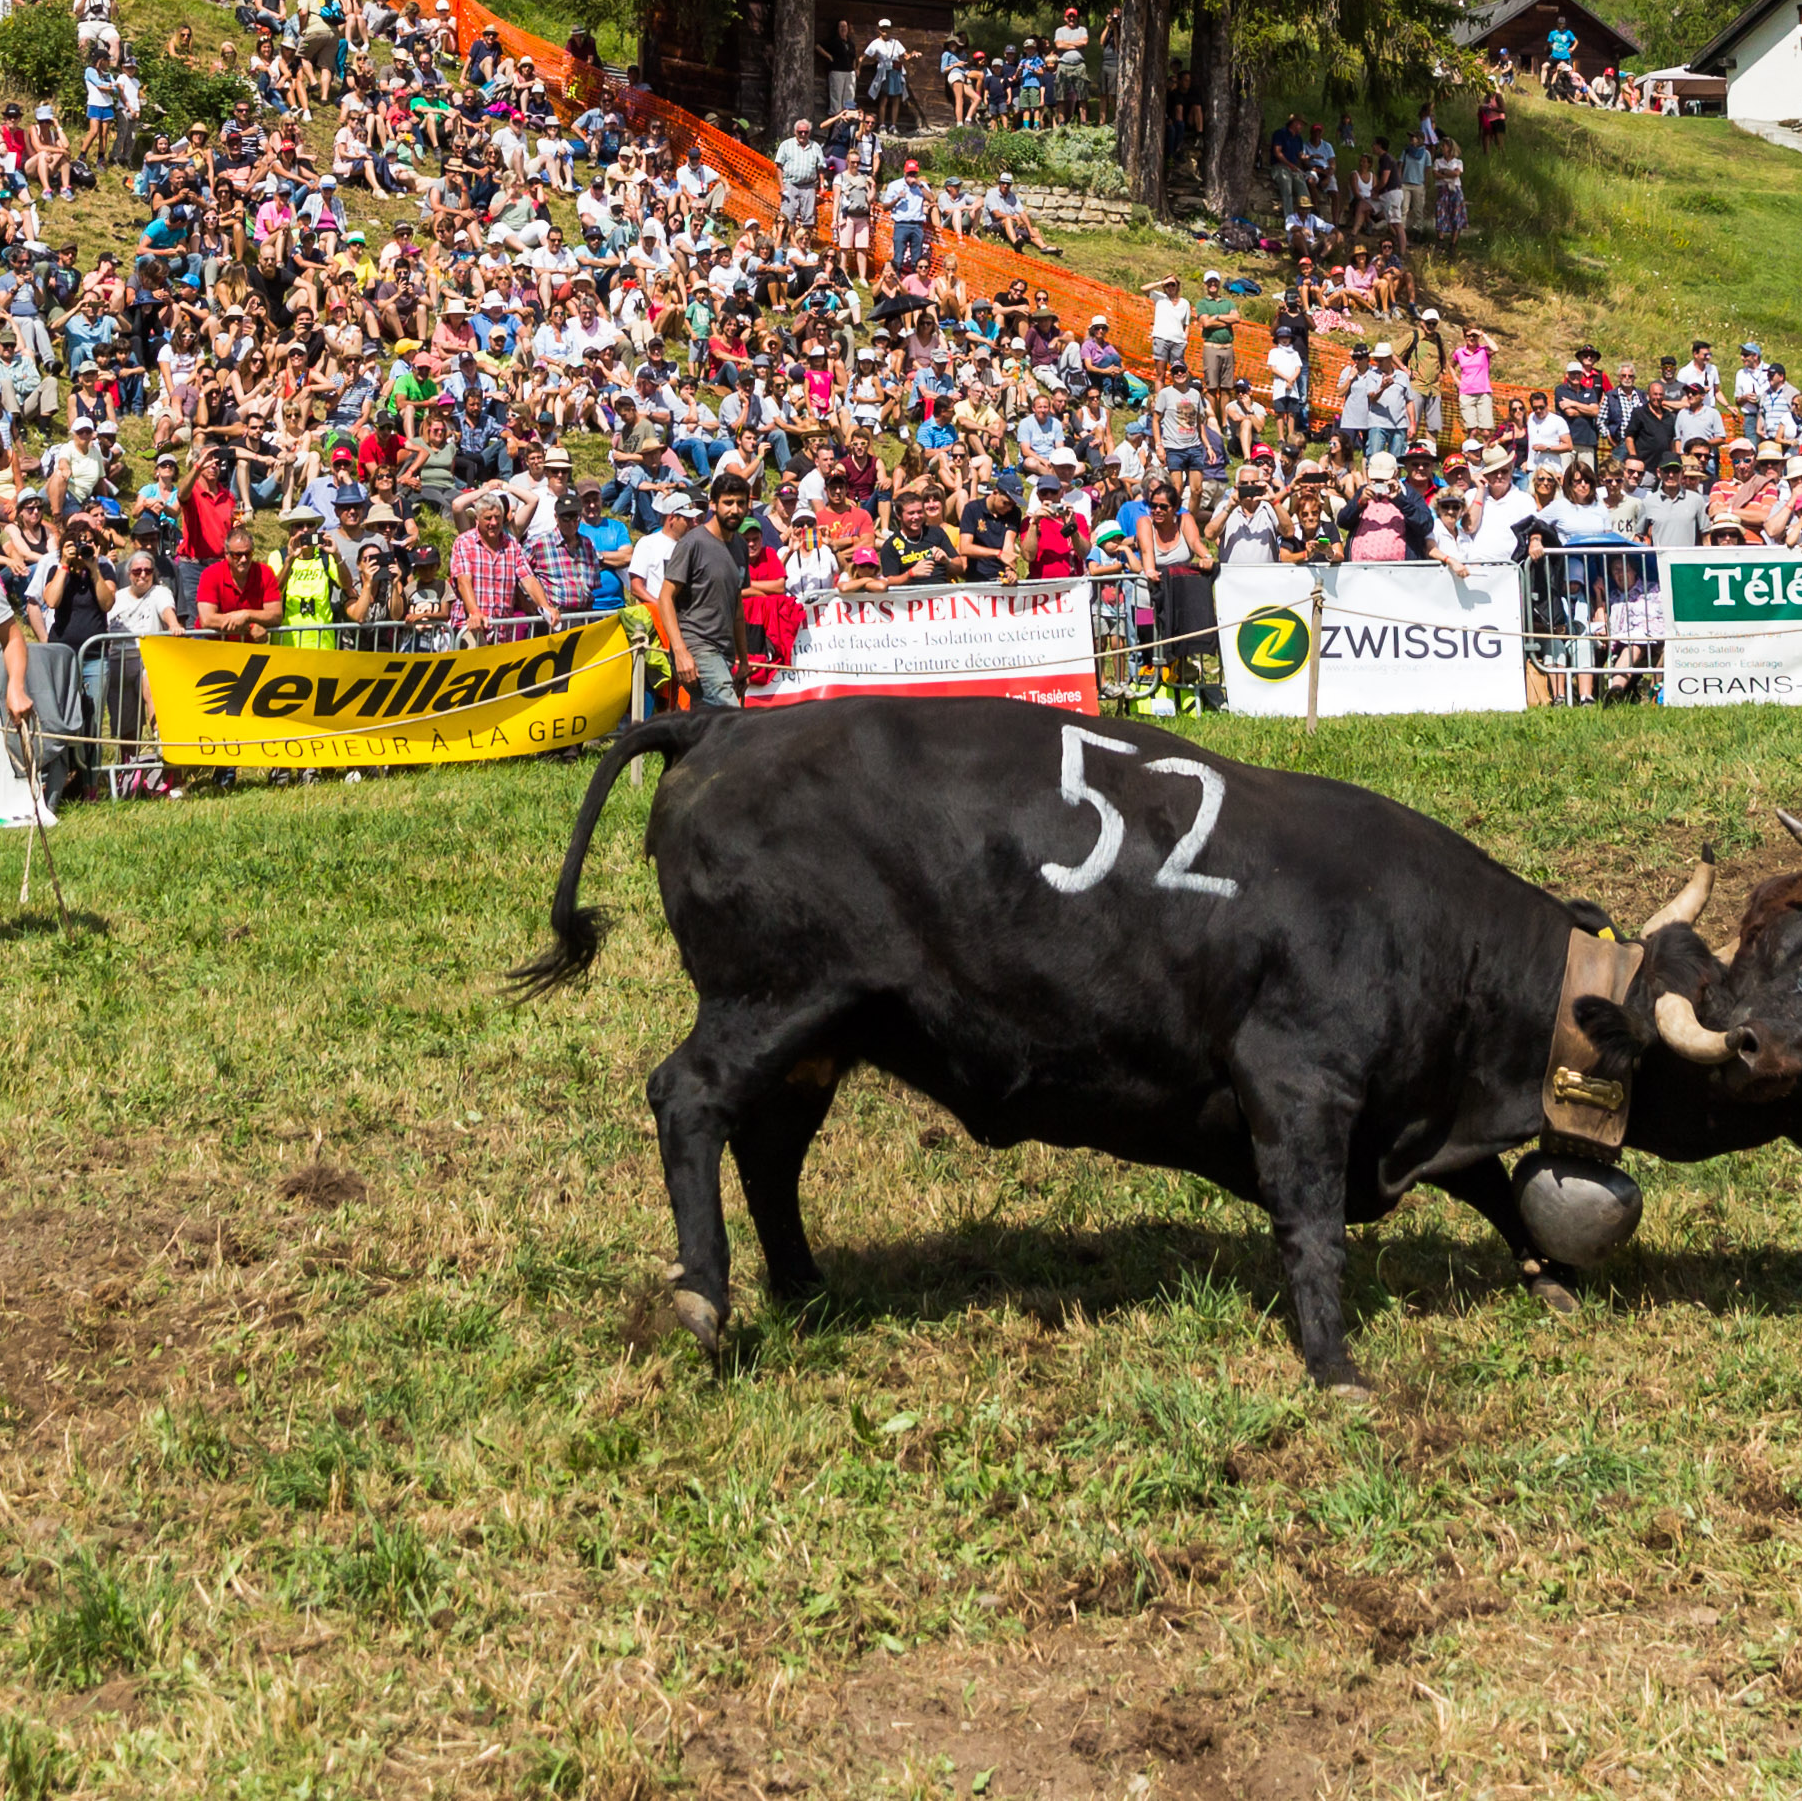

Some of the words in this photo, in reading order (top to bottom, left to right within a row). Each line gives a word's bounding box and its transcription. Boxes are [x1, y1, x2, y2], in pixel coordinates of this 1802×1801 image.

[907, 589, 1075, 622] PEINTURE
[827, 634, 845, 650] de
[850, 633, 908, 652] façades
[925, 628, 993, 647] Isolation
[998, 624, 1076, 642] extérieure
[1320, 624, 1502, 659] ZWISSIG
[195, 631, 585, 719] devillard
[894, 655, 960, 673] Peinture
[965, 651, 1046, 670] décorative
[1029, 688, 1082, 705] Tissières
[198, 735, 242, 756] DU
[260, 735, 411, 758] COPIEUR
[431, 727, 450, 752] À
[467, 726, 509, 749] LA
[528, 715, 588, 743] GED
[1040, 724, 1239, 898] 52
